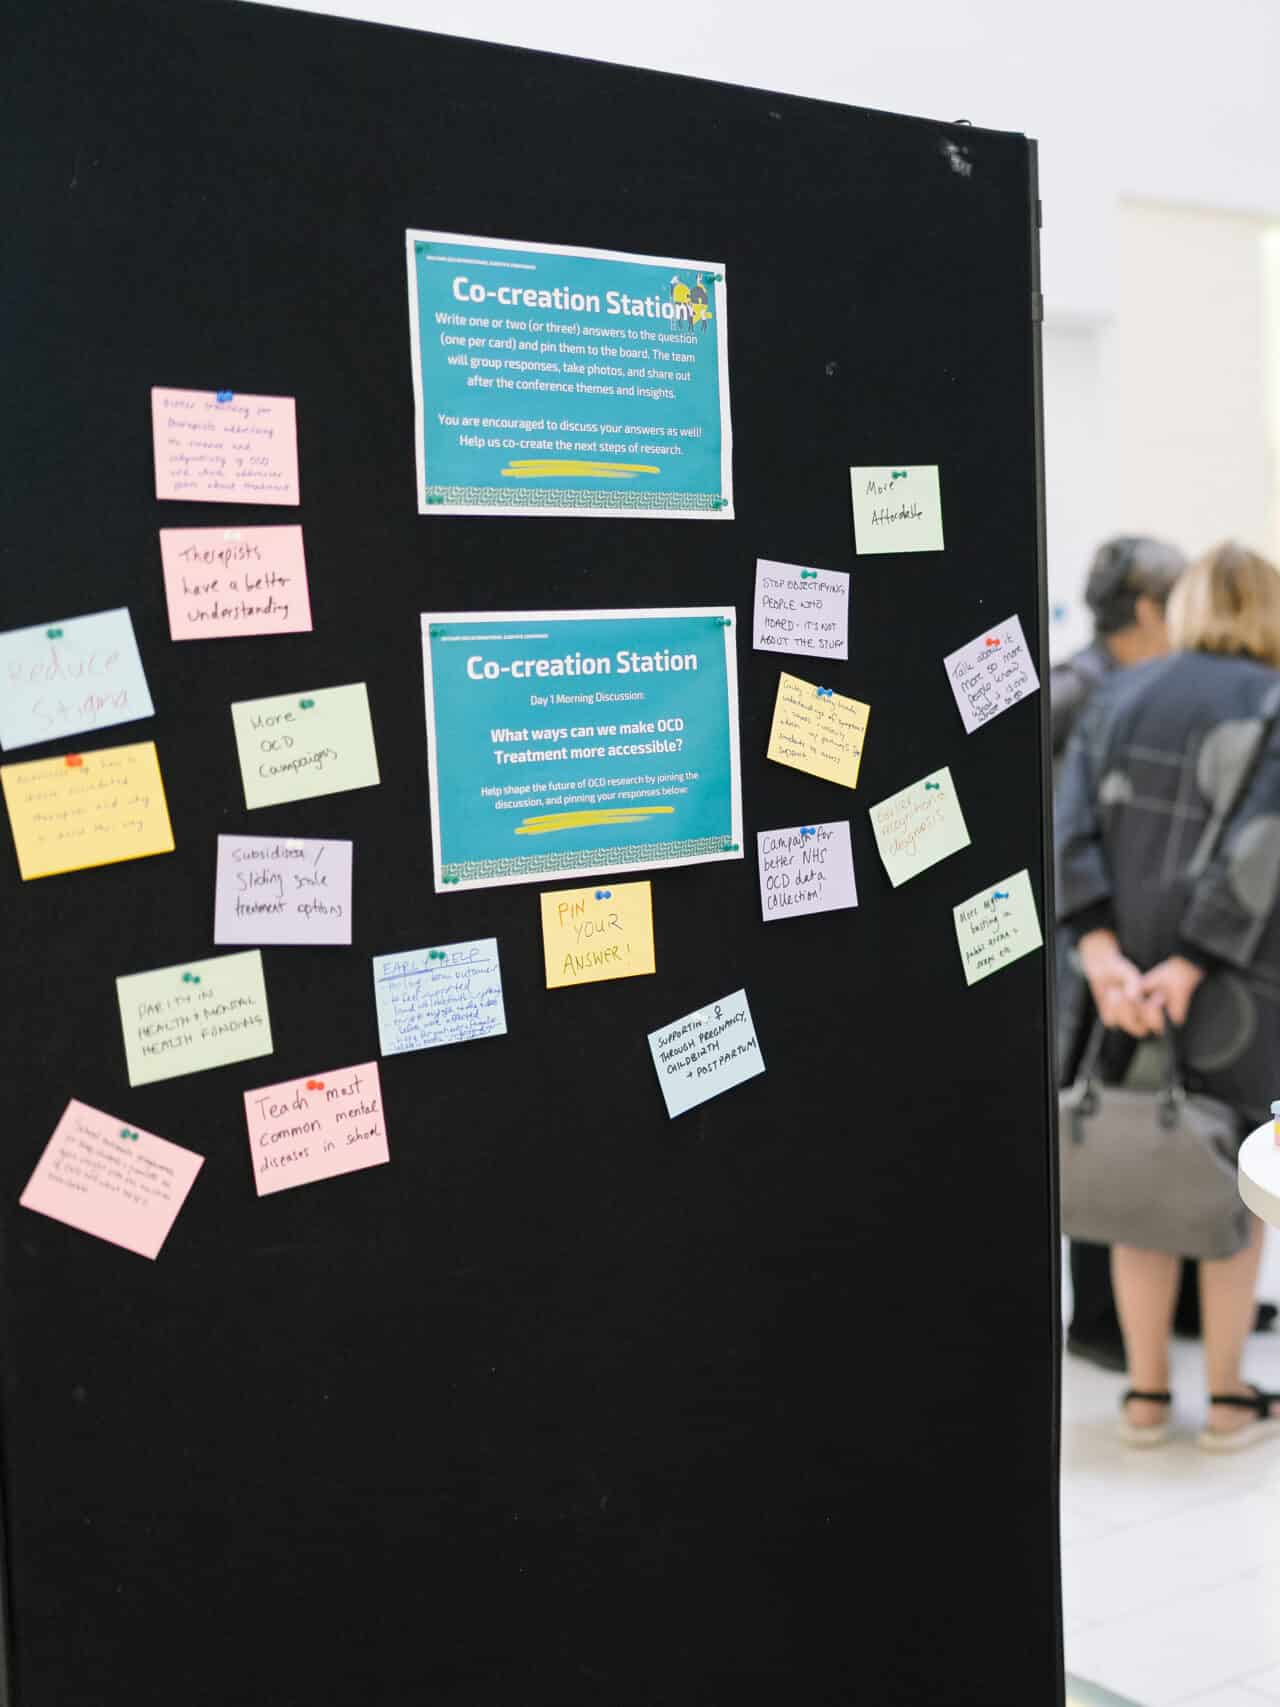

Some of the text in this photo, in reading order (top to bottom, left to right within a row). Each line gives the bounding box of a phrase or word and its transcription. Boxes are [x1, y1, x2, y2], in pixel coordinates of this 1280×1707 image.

[452, 275, 689, 321] Co-creation Station
[435, 311, 466, 327] Write
[468, 318, 489, 328] one
[491, 319, 503, 329] or
[506, 319, 527, 331] two
[528, 320, 545, 333] (or
[583, 326, 627, 339] answers
[628, 328, 639, 340] to
[640, 329, 657, 341] the
[658, 333, 698, 346] question
[440, 331, 465, 347] (one
[468, 337, 486, 349] per
[488, 336, 517, 351] card)
[518, 340, 539, 352] and
[540, 341, 557, 355] pin
[559, 342, 586, 355] them
[587, 344, 599, 356] to
[601, 344, 617, 357] the
[653, 349, 670, 361] The
[672, 351, 696, 363] team
[447, 353, 469, 367] will
[470, 356, 502, 370] group
[503, 359, 562, 374] responses,
[563, 362, 586, 375] take
[627, 367, 646, 378] and
[648, 367, 674, 380] share
[675, 370, 692, 382] out
[467, 374, 493, 388] after
[495, 376, 514, 390] the
[515, 379, 575, 393] conference
[576, 382, 615, 396] themes
[616, 385, 635, 397] and
[437, 412, 460, 427] You
[462, 416, 481, 427] are
[482, 416, 545, 433] encouraged
[546, 419, 558, 431] to
[559, 419, 599, 433] discuss
[599, 423, 623, 436] your
[624, 424, 666, 437] answers
[667, 426, 679, 438] as
[459, 433, 486, 449] Help
[487, 438, 502, 449] us
[502, 438, 554, 451] co-create
[555, 438, 573, 452] the
[574, 440, 598, 453] next
[599, 442, 627, 456] steps
[628, 441, 640, 454] of
[866, 480, 895, 496] More
[181, 570, 291, 596] have a better
[762, 576, 785, 590] STOP
[762, 594, 798, 611] PEOPLE
[760, 634, 790, 647] ABOUT
[793, 637, 816, 649] THE
[466, 648, 698, 680] Co-creation Station
[529, 694, 549, 708] Day
[556, 691, 595, 705] Morning
[249, 711, 297, 731] More
[490, 717, 685, 743] What ways can we make OCD
[260, 734, 295, 753] OCD
[493, 737, 684, 765] Treatment more accessible?
[480, 770, 699, 799] Help shape the future of OCD research by joining the
[545, 795, 562, 807] and
[563, 792, 596, 807] pinning
[596, 791, 617, 803] your
[617, 786, 662, 801] responses
[762, 831, 811, 855] Campaign
[763, 847, 828, 872] better NHS
[766, 869, 827, 890] OCD data
[235, 895, 344, 921] treatment options
[557, 897, 586, 929] PIN
[573, 912, 624, 945] YOUR
[562, 943, 631, 977] ANSWER!
[658, 1039, 696, 1063] THROUGH
[666, 1039, 721, 1075] CHILDBIRTH
[254, 1074, 365, 1121] Teach most
[334, 1098, 379, 1124] mental
[259, 1122, 382, 1174] diseases in school
